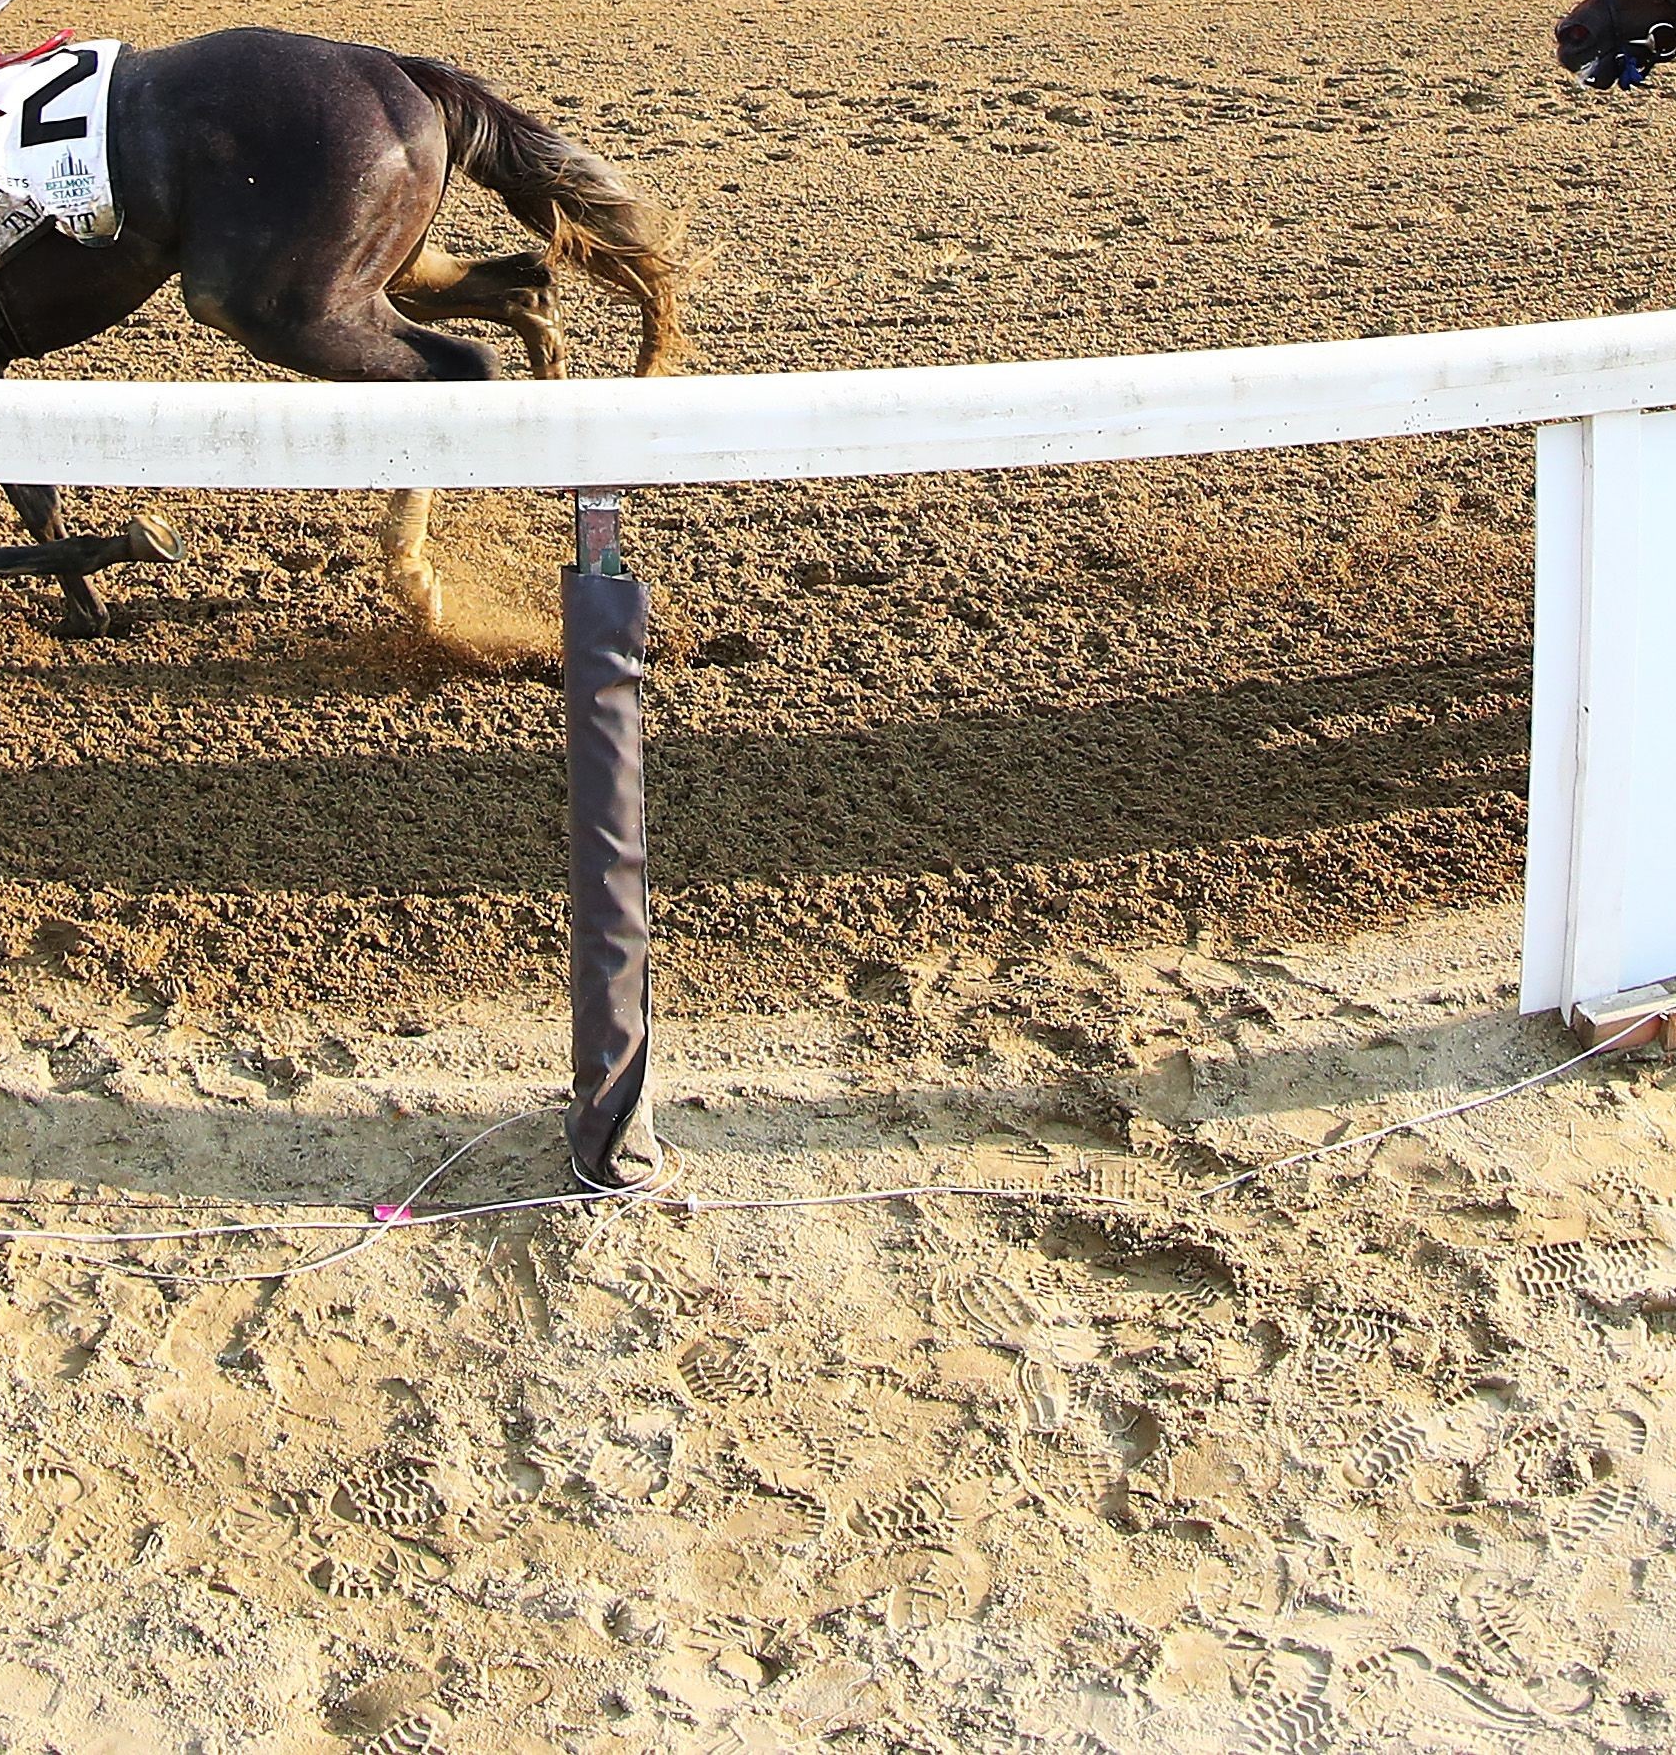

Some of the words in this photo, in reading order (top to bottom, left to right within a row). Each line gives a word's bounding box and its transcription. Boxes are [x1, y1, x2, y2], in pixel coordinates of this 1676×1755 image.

[20, 48, 98, 148] 2
[45, 176, 95, 191] BELMONT
[52, 187, 92, 200] STAKES
